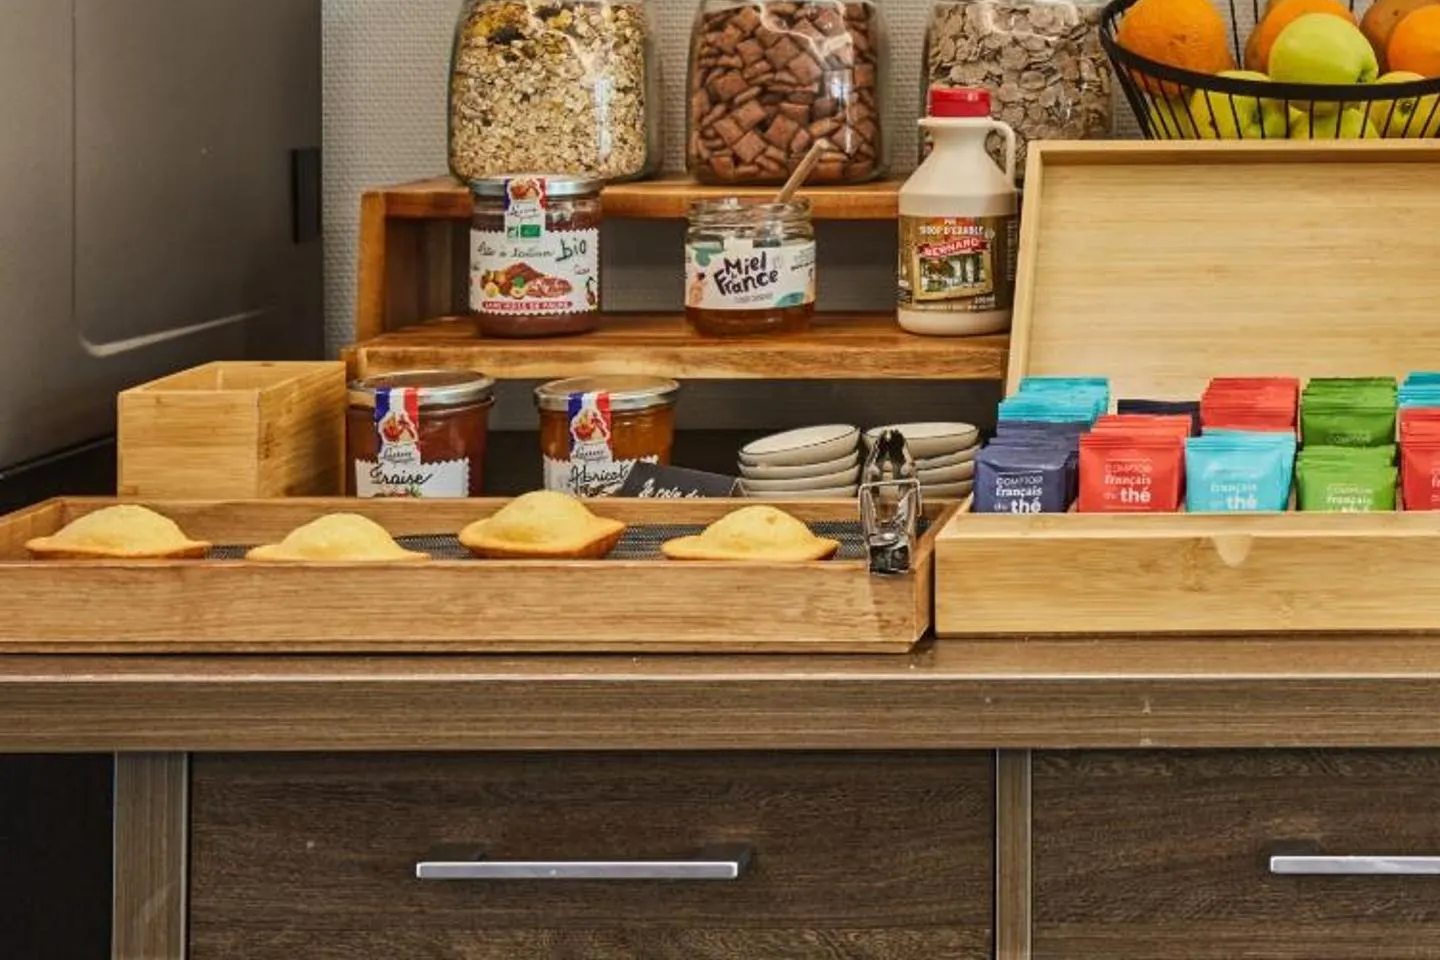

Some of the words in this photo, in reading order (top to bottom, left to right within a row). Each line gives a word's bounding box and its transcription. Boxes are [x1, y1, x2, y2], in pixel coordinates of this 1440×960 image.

[555, 238, 587, 262] bio
[723, 250, 767, 275] Miel
[713, 269, 779, 296] France
[369, 462, 433, 485] Fraise
[567, 463, 630, 486] Abricot
[1104, 474, 1152, 488] français
[995, 485, 1042, 498] français
[1120, 487, 1151, 503] thé
[1210, 481, 1257, 495] français
[1011, 497, 1042, 513] thé
[1227, 493, 1258, 510] thé
